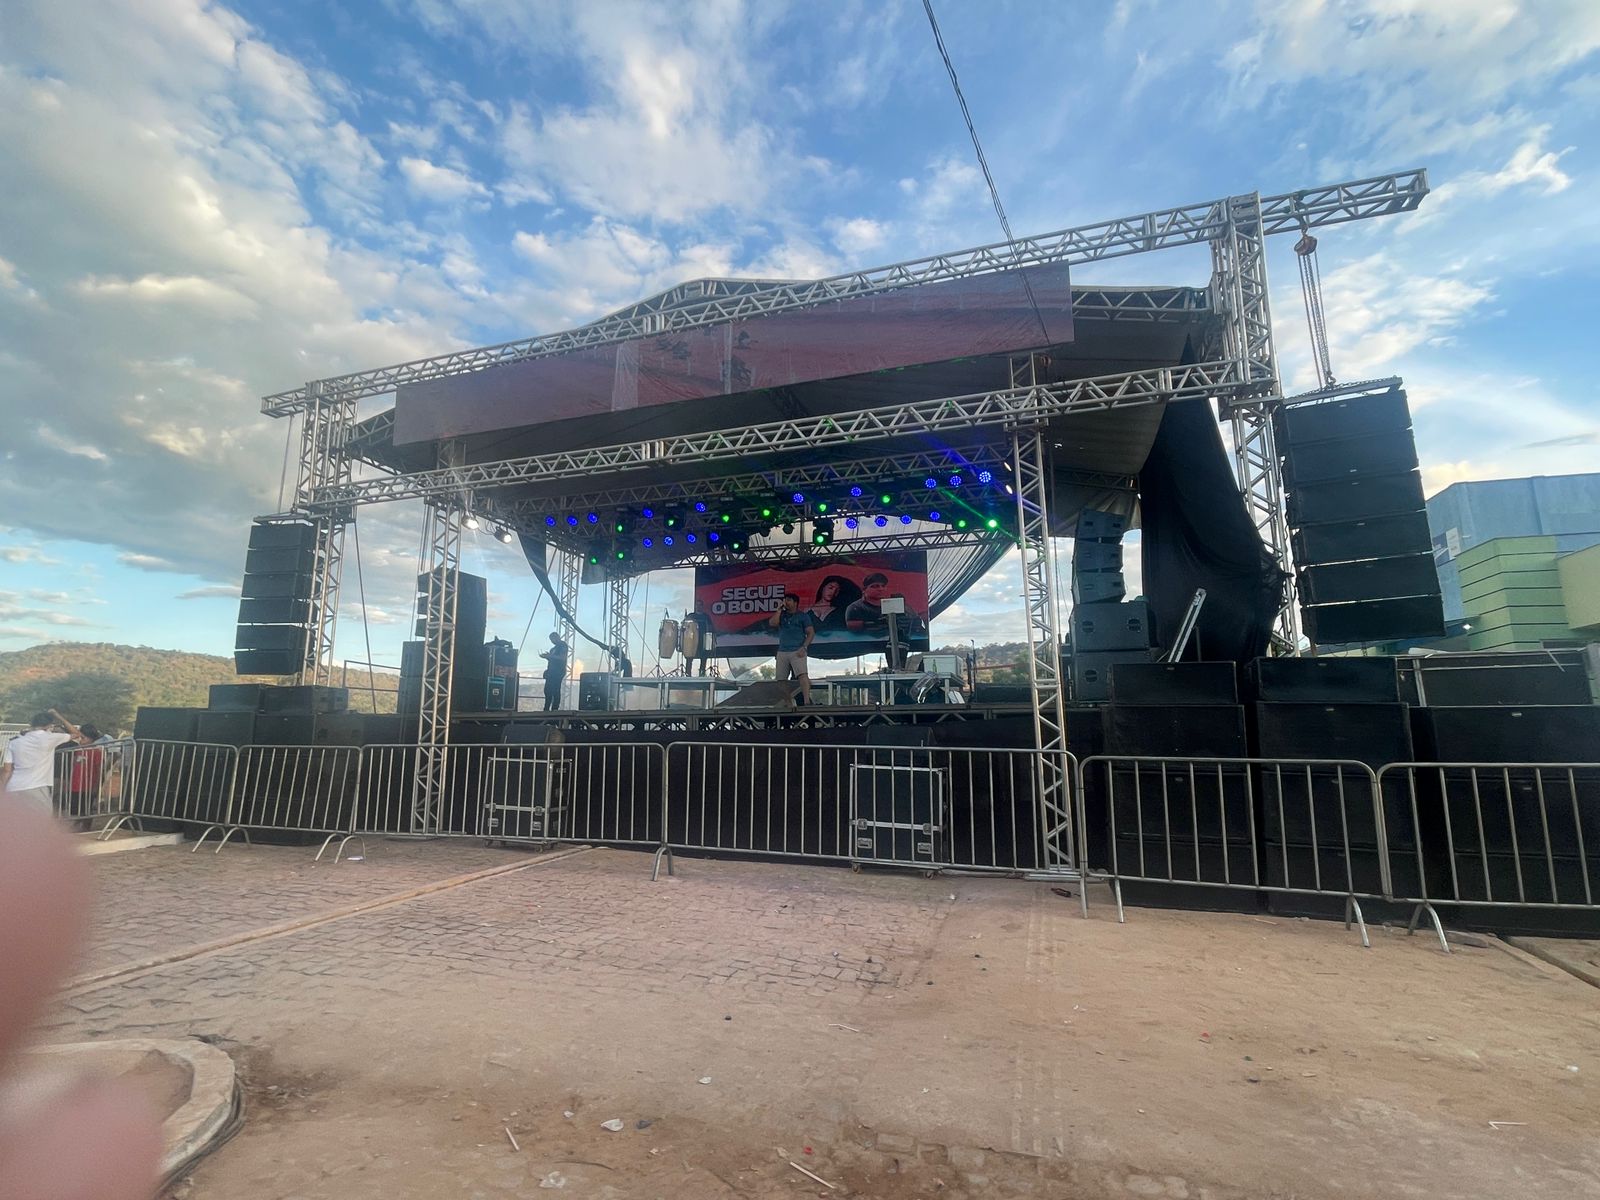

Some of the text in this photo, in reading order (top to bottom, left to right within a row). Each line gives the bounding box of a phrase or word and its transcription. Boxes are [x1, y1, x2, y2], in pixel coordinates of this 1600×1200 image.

[721, 584, 785, 601] SEGUE
[711, 598, 785, 615] O BOND
